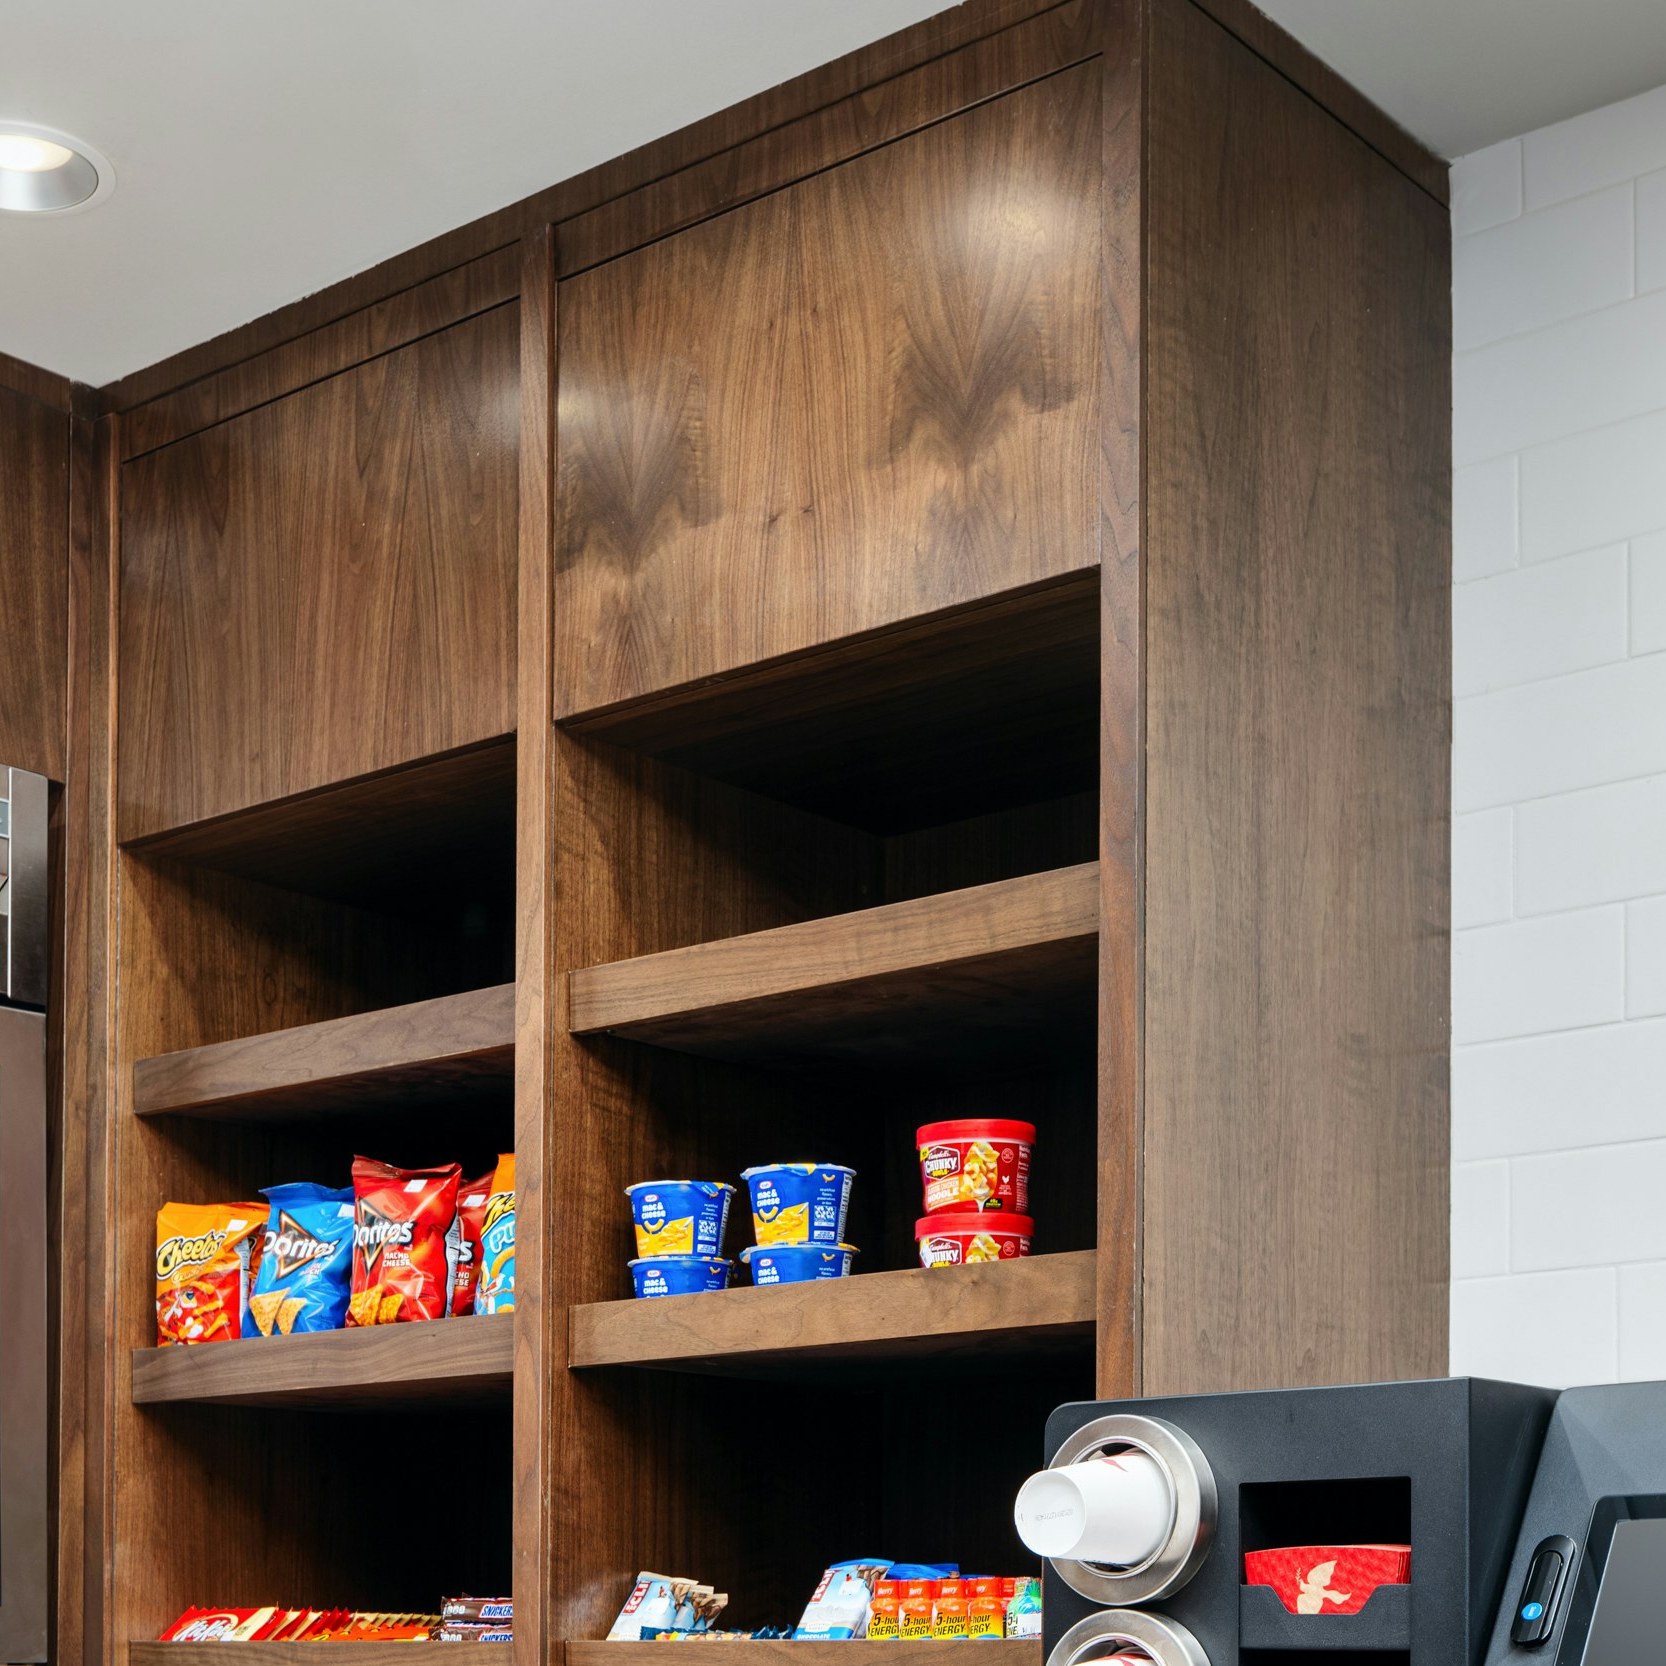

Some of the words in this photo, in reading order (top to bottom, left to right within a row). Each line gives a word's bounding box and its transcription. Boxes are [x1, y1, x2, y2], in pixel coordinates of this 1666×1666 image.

[925, 1157, 957, 1171] CHUNKY
[757, 1190, 770, 1199] mac
[770, 1188, 778, 1198] &
[927, 1187, 960, 1204] NOODLE
[642, 1203, 656, 1212] mac
[656, 1202, 664, 1211] &
[353, 1221, 415, 1248] Doritos
[263, 1230, 338, 1261] Doritos
[157, 1229, 226, 1277] Cheetos
[384, 1251, 410, 1260] NACHO
[382, 1259, 410, 1268] CHEESE
[758, 1268, 770, 1277] mac
[770, 1266, 777, 1276] &
[644, 1279, 657, 1287] mac
[657, 1277, 665, 1286] &
[877, 1585, 894, 1596] Berry
[909, 1585, 923, 1596] Berry
[941, 1584, 958, 1595] Berry
[904, 1612, 931, 1626] 5-hour
[936, 1611, 967, 1626] 5-hour
[900, 1626, 931, 1637] ENERGY
[933, 1625, 966, 1636] ENERGY
